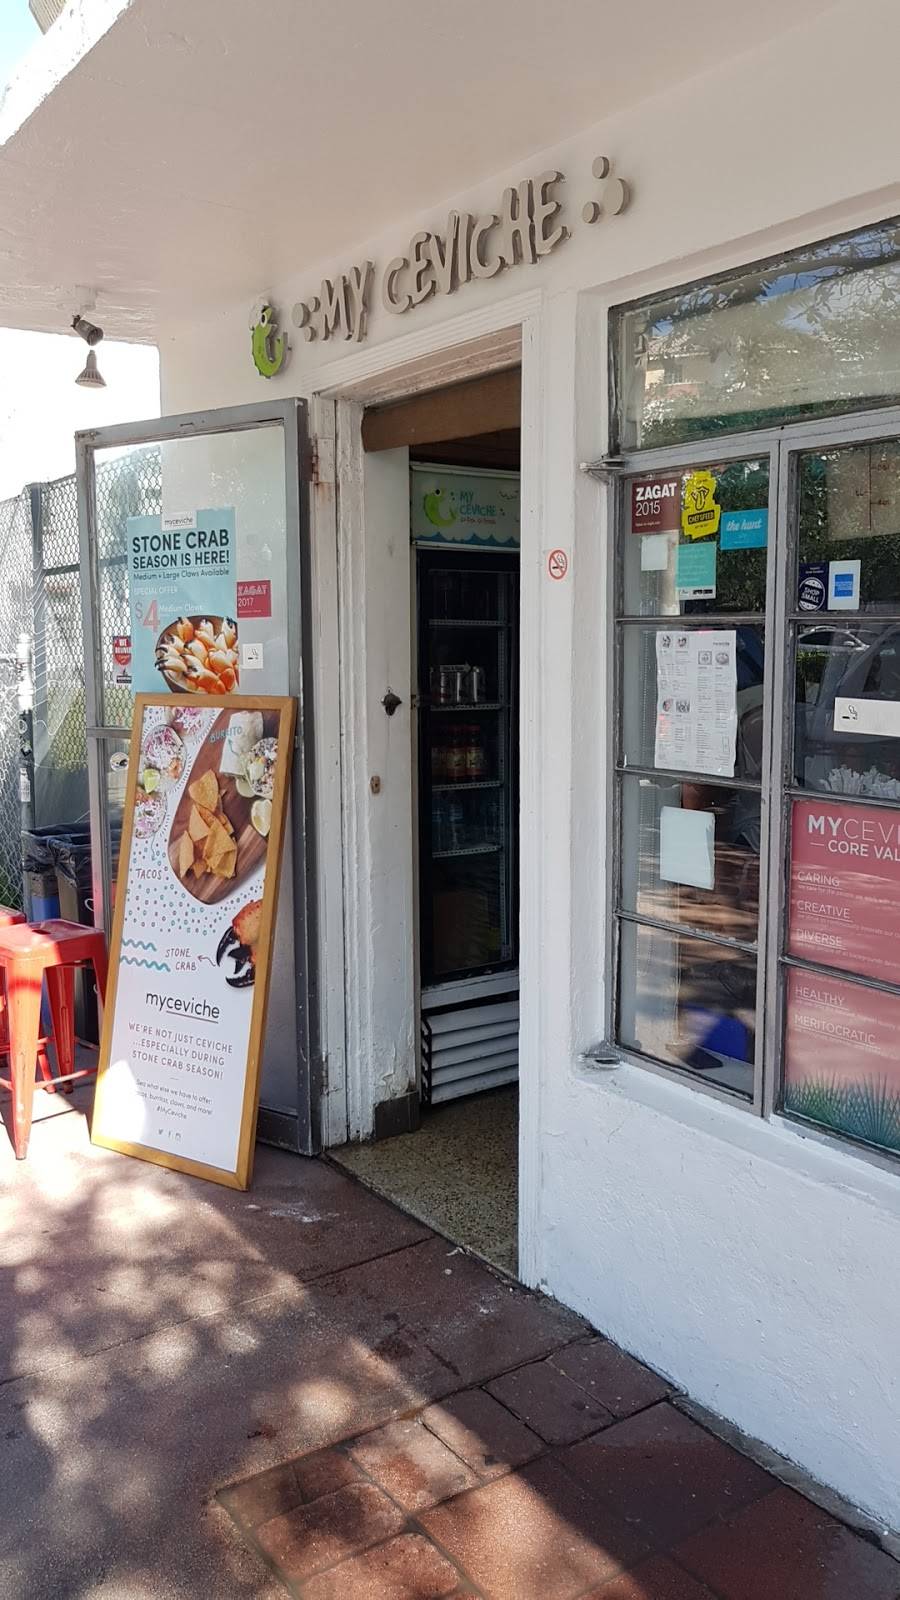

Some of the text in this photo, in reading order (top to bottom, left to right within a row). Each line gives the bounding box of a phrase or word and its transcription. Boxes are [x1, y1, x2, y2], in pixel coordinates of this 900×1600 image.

[319, 170, 572, 342] MY CEVICHE
[636, 482, 677, 501] ZAGAT
[635, 500, 661, 517] 2015
[164, 517, 193, 527] myceviche
[725, 519, 740, 532] the
[132, 529, 230, 554] STONE CRAB
[133, 549, 230, 570] SEASON IS HERE!
[133, 567, 230, 581] Medium Large Claws Available
[238, 585, 268, 596] ZAGAT
[238, 597, 254, 607] 2017
[827, 839, 869, 857] CORE
[135, 868, 162, 880] TACOS
[797, 871, 840, 887] CARING
[796, 900, 851, 919] CREATIVE
[795, 928, 843, 947] DIVERSE
[165, 948, 191, 958] STONE
[175, 960, 197, 972] CRAB
[795, 986, 845, 1006] HEALTHY
[145, 992, 220, 1020] myceviche
[128, 1022, 233, 1054] WE'RE NOT JUST CEVICHE
[794, 1014, 876, 1045] MERITOCRATIC
[132, 1050, 224, 1080] STONE CRAB SEASON!
[191, 1050, 225, 1066] DURING
